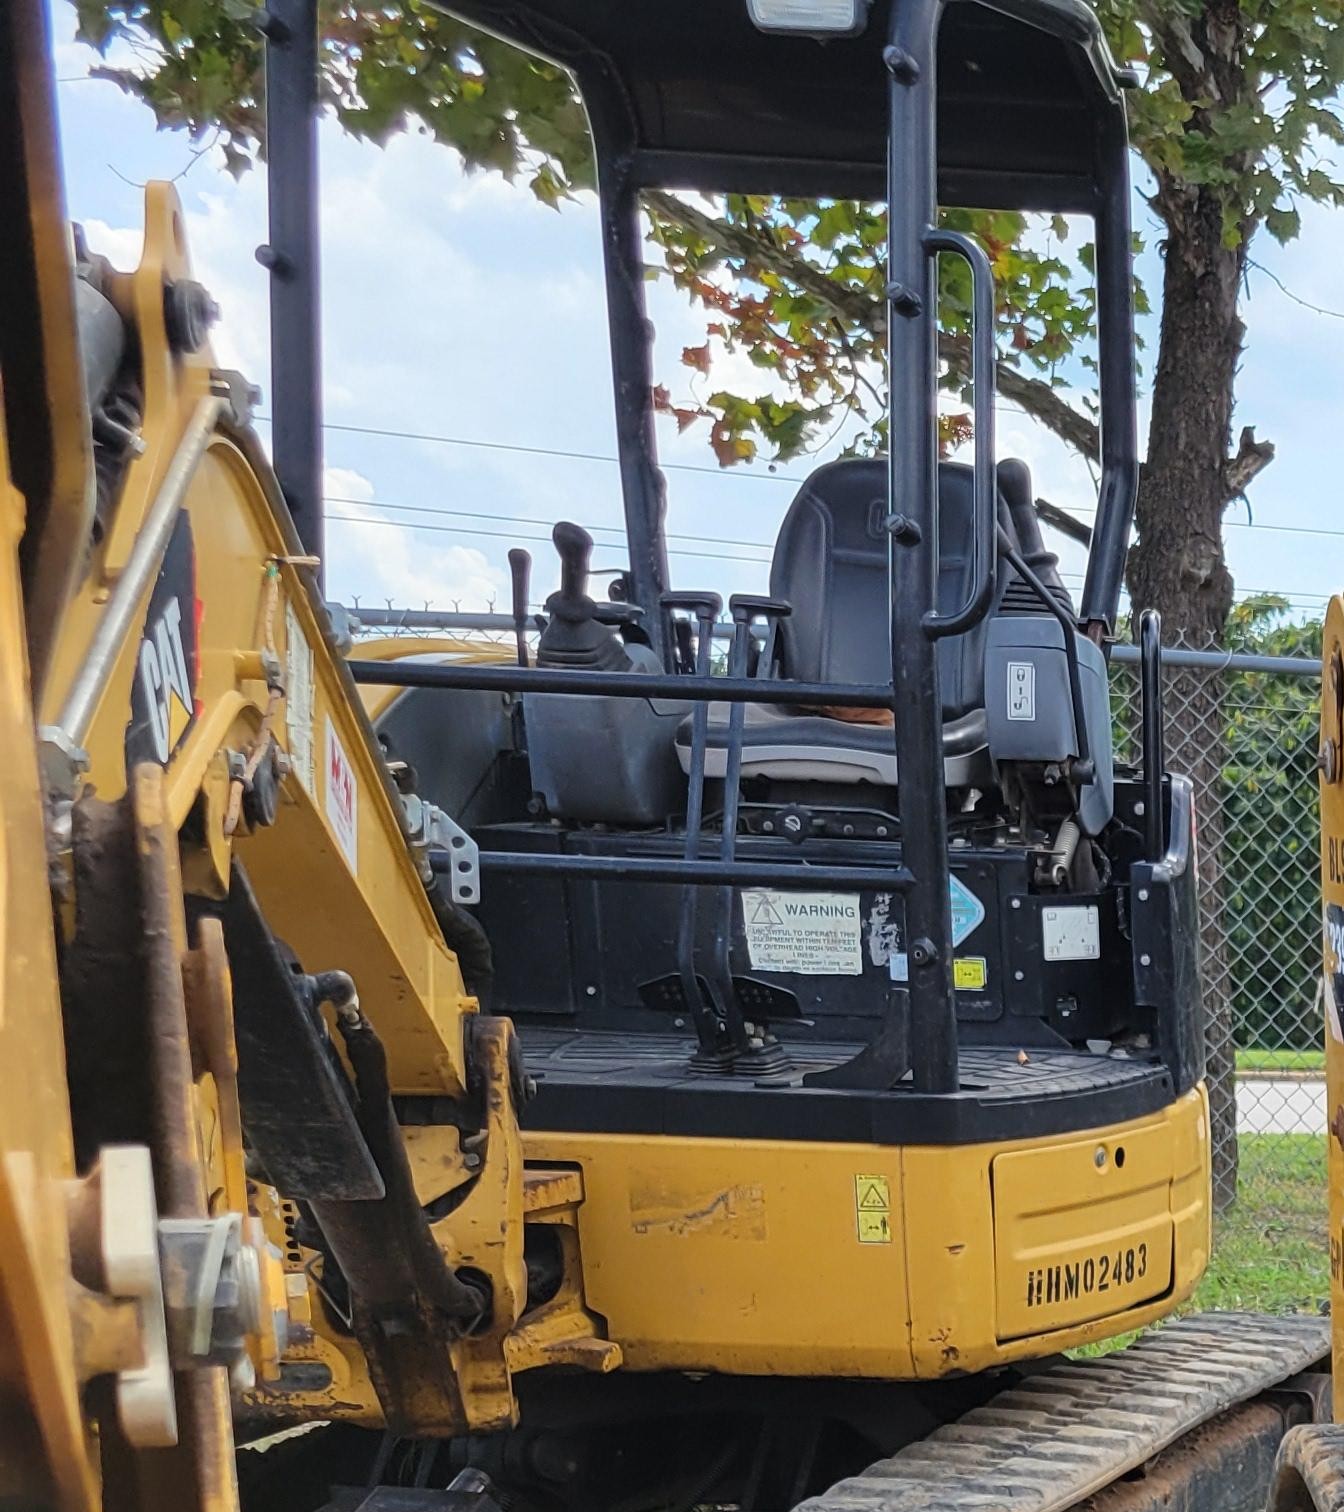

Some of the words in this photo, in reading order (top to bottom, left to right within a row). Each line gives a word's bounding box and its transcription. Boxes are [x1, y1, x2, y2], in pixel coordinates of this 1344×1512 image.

[141, 597, 193, 763] CAT
[785, 904, 855, 918] WARNING
[1026, 1243, 1147, 1307] HHM02483
